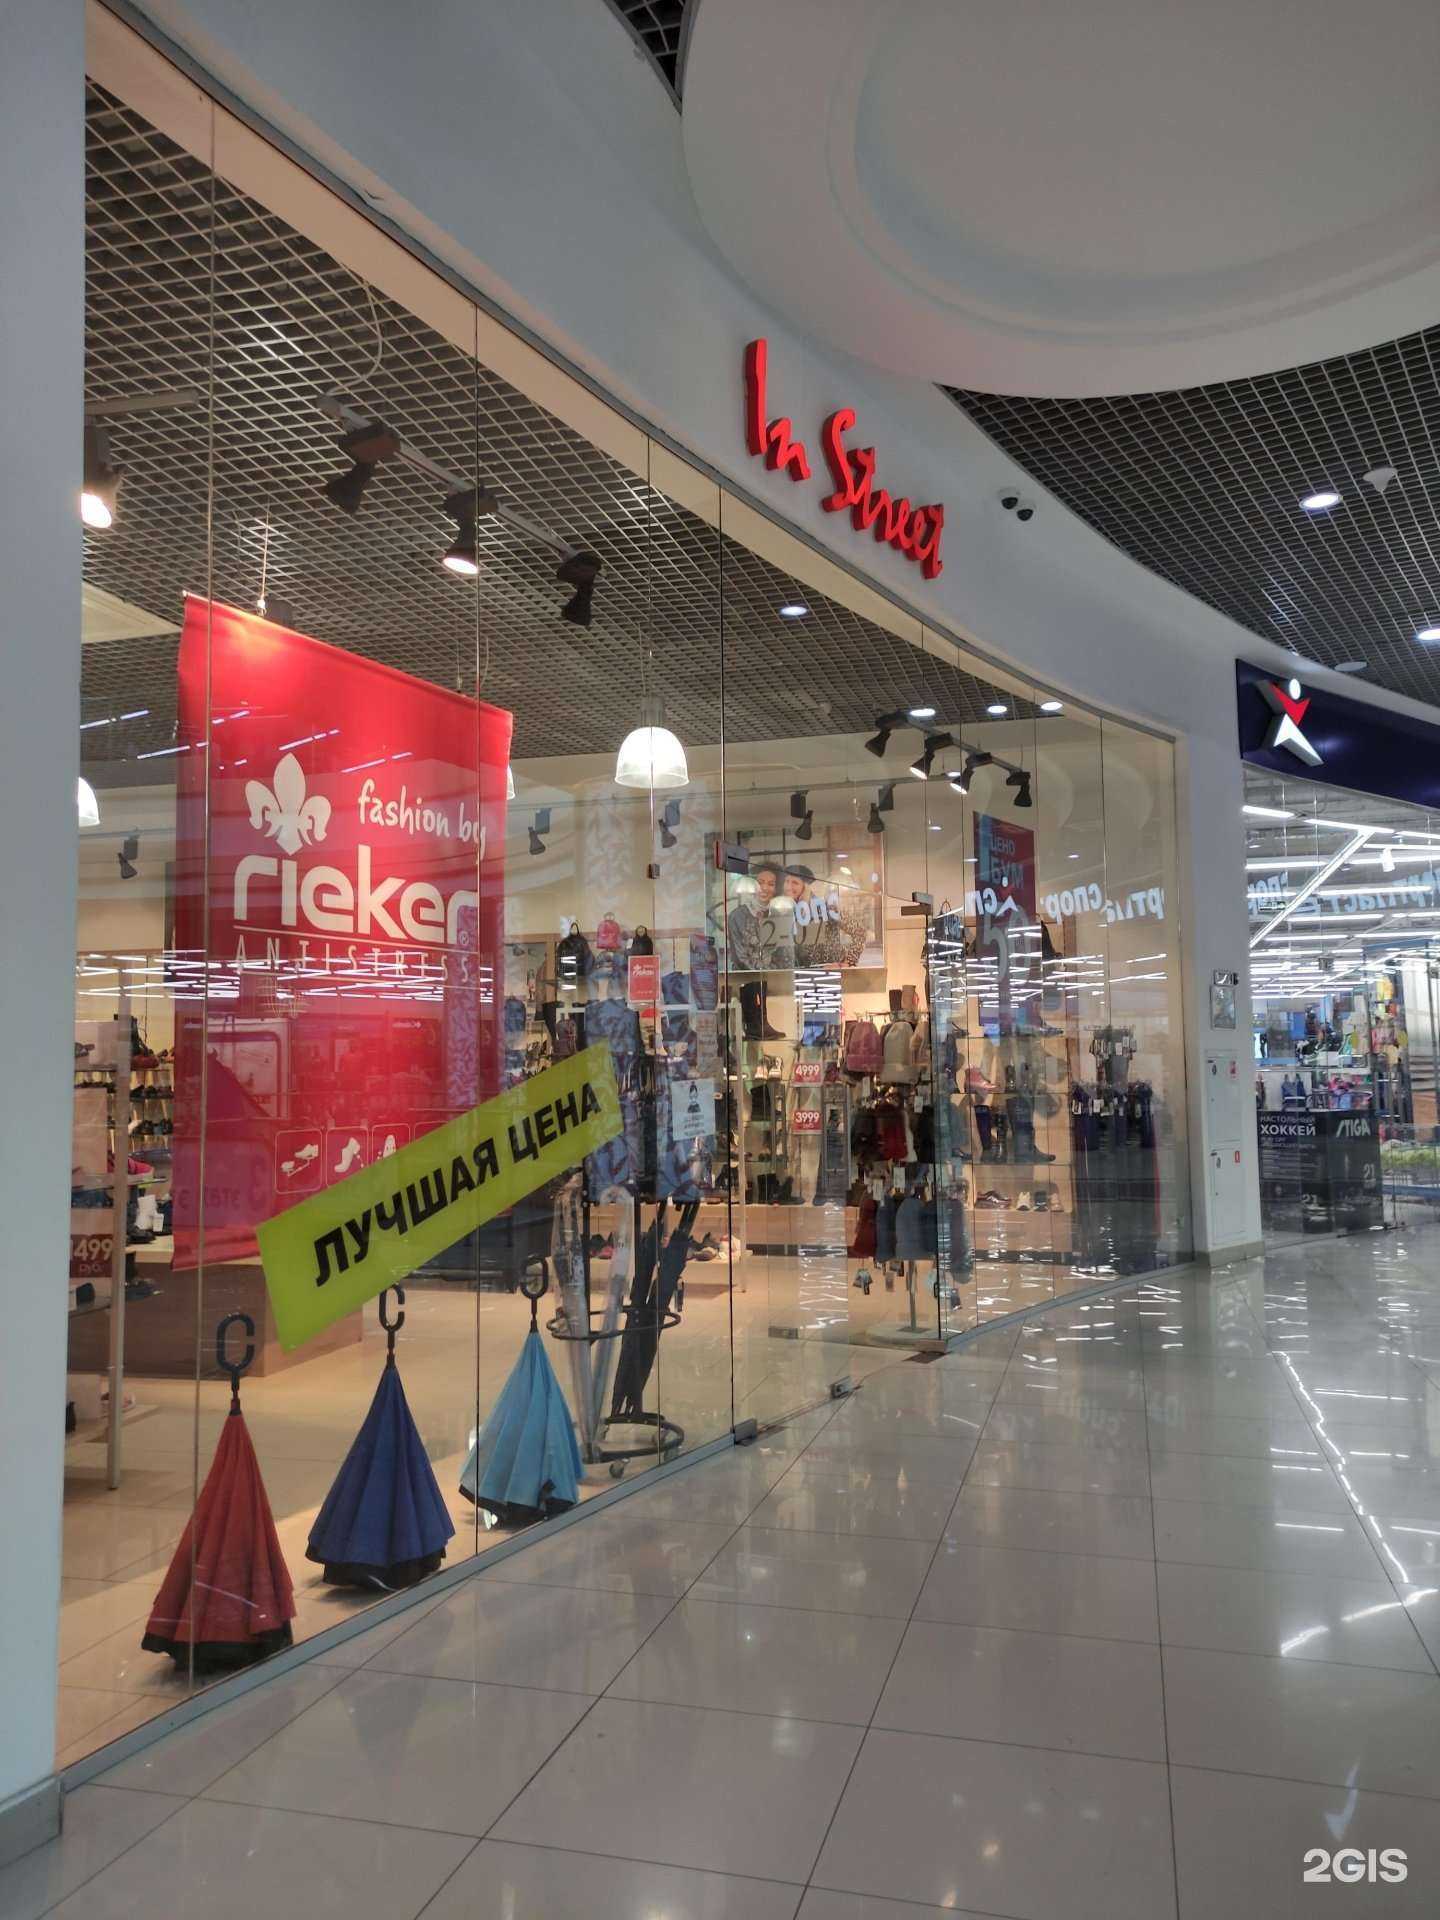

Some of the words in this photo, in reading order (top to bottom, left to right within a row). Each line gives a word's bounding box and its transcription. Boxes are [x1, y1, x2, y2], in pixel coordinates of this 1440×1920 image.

[744, 337, 812, 481] In
[357, 778, 451, 837] fashion
[458, 802, 487, 864] by
[233, 844, 479, 945] rieker
[234, 934, 470, 983] ANTISTRESS
[795, 1064, 820, 1076] 4999
[795, 1111, 820, 1123] 3999
[1260, 1123, 1316, 1136] ХОККЕЙ
[1335, 1119, 1371, 1138] STIGA
[313, 1137, 500, 1288] ЛУЧШАЯ
[507, 1082, 602, 1164] ЦЕНА
